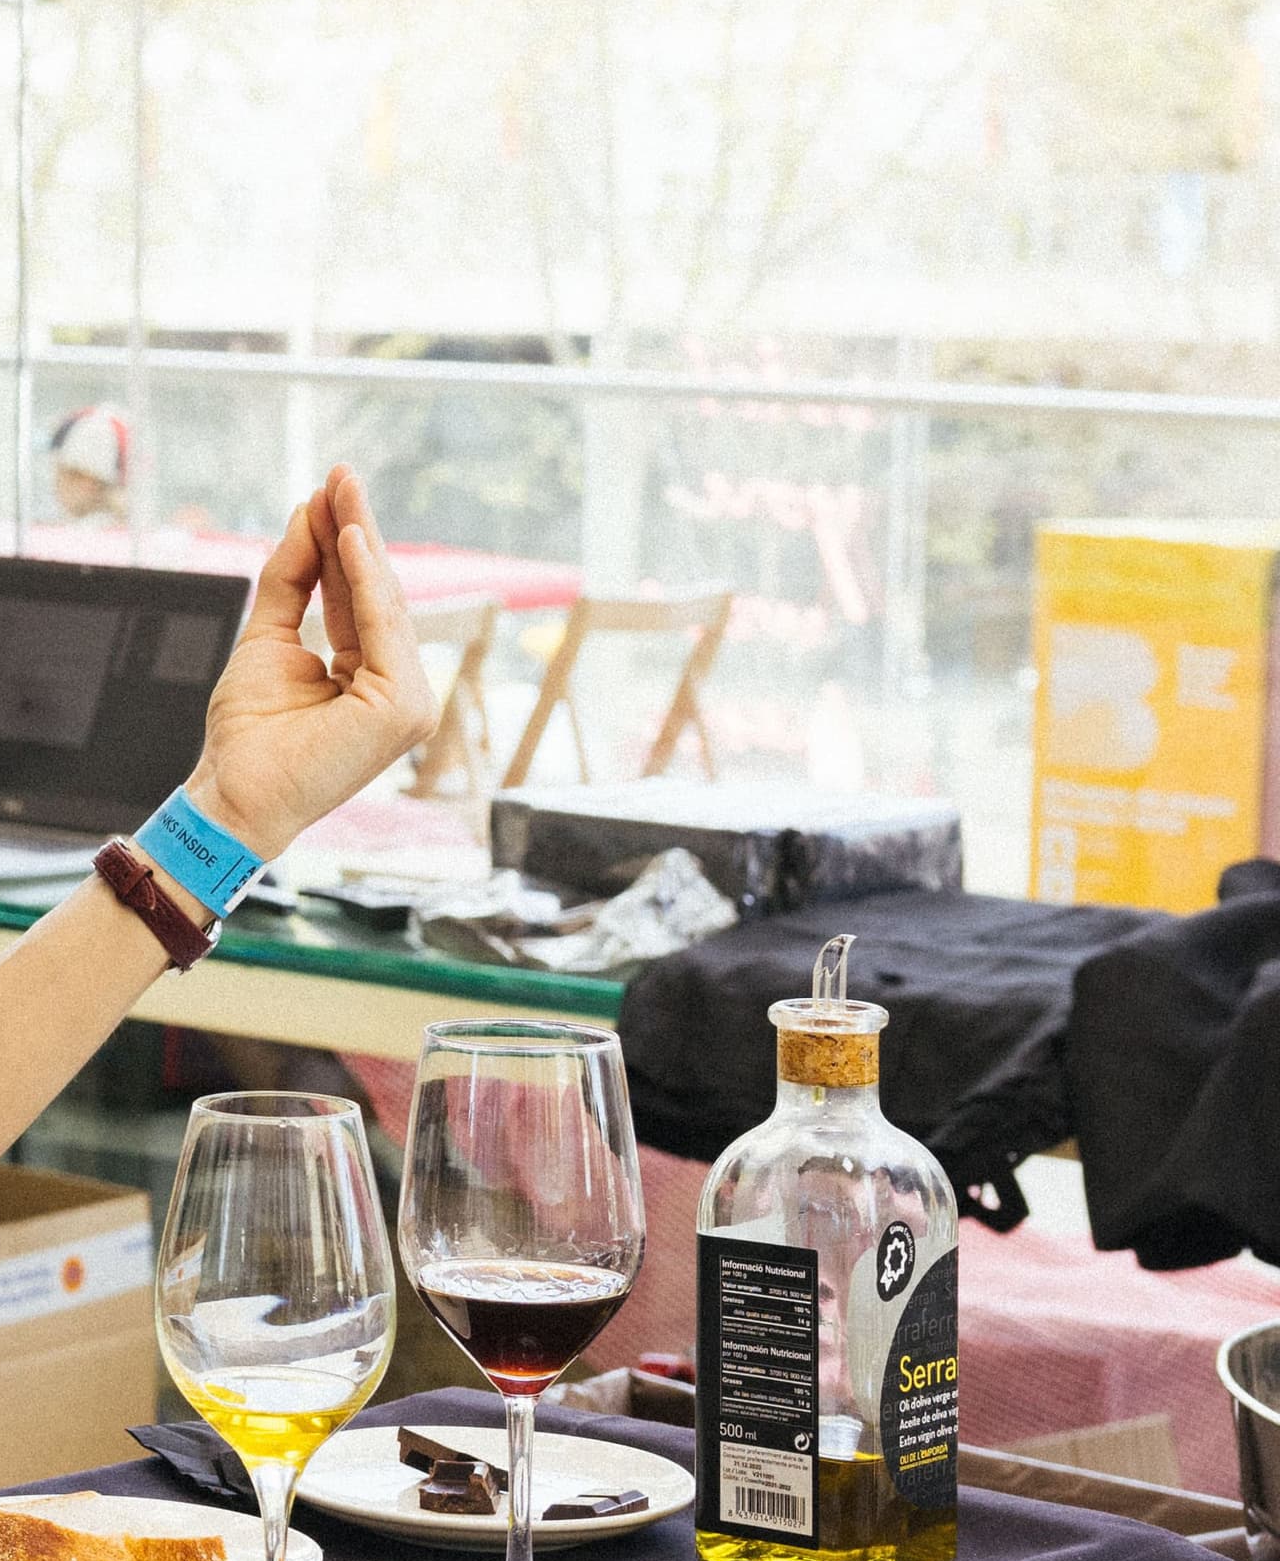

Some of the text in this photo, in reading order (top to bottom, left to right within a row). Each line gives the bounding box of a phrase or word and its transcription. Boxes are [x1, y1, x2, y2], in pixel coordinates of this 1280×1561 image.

[175, 827, 218, 869] INSIDE
[721, 1259, 806, 1279] Informació Nutricional
[722, 1340, 811, 1361] Información Nutricional
[899, 1355, 959, 1393] Serra
[900, 1399, 910, 1413] Oli
[932, 1391, 951, 1405] verge
[899, 1416, 921, 1430] Aceite
[921, 1411, 931, 1424] de
[931, 1408, 948, 1421] oliva
[720, 1422, 758, 1441] 500 ml
[899, 1435, 917, 1448] Extra
[917, 1428, 936, 1444] virgin
[936, 1424, 953, 1437] olive
